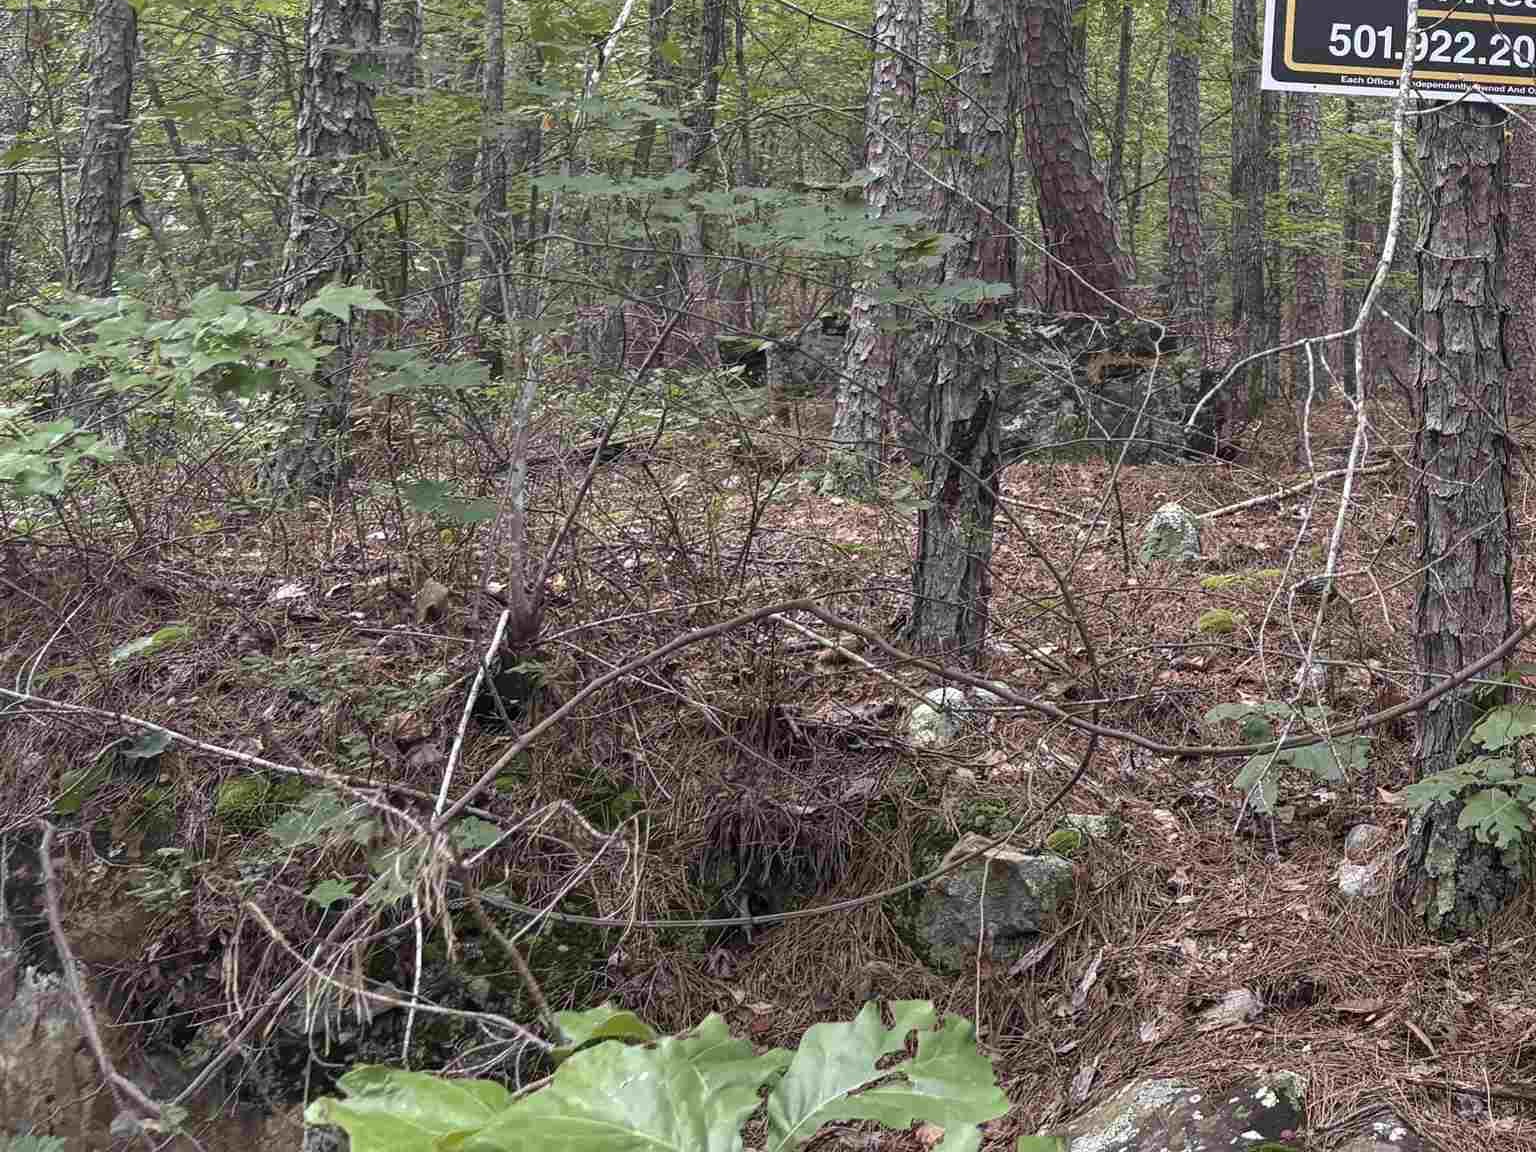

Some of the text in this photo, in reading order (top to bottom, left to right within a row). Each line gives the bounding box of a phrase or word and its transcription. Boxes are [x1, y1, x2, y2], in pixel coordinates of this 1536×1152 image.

[1341, 75, 1364, 84] Each
[1367, 76, 1394, 86] Office
[1406, 79, 1472, 91] ndependentl
[1474, 83, 1505, 93] wned
[1507, 86, 1526, 94] And
